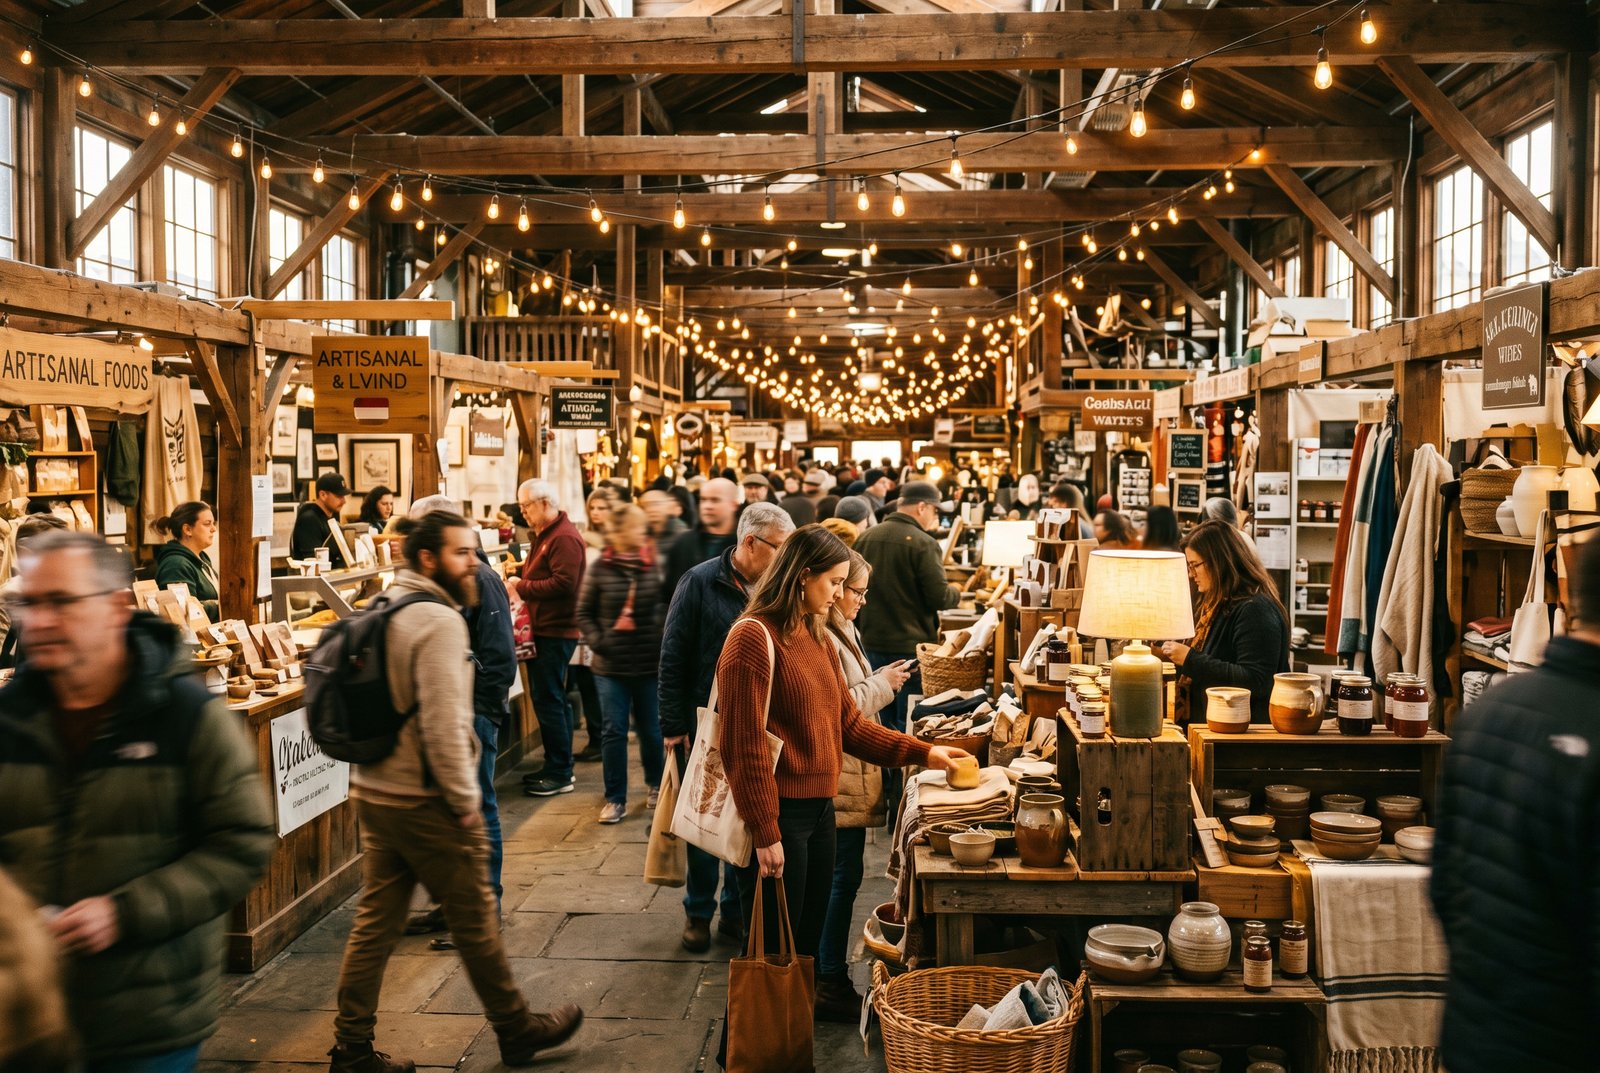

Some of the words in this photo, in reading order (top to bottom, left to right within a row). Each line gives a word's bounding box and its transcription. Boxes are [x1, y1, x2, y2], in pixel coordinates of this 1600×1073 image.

[317, 350, 423, 367] ARTISANAL
[2, 349, 99, 386] ARTISANAL
[104, 360, 148, 390] FOODS
[332, 374, 344, 389] &
[349, 372, 407, 389] LVIND
